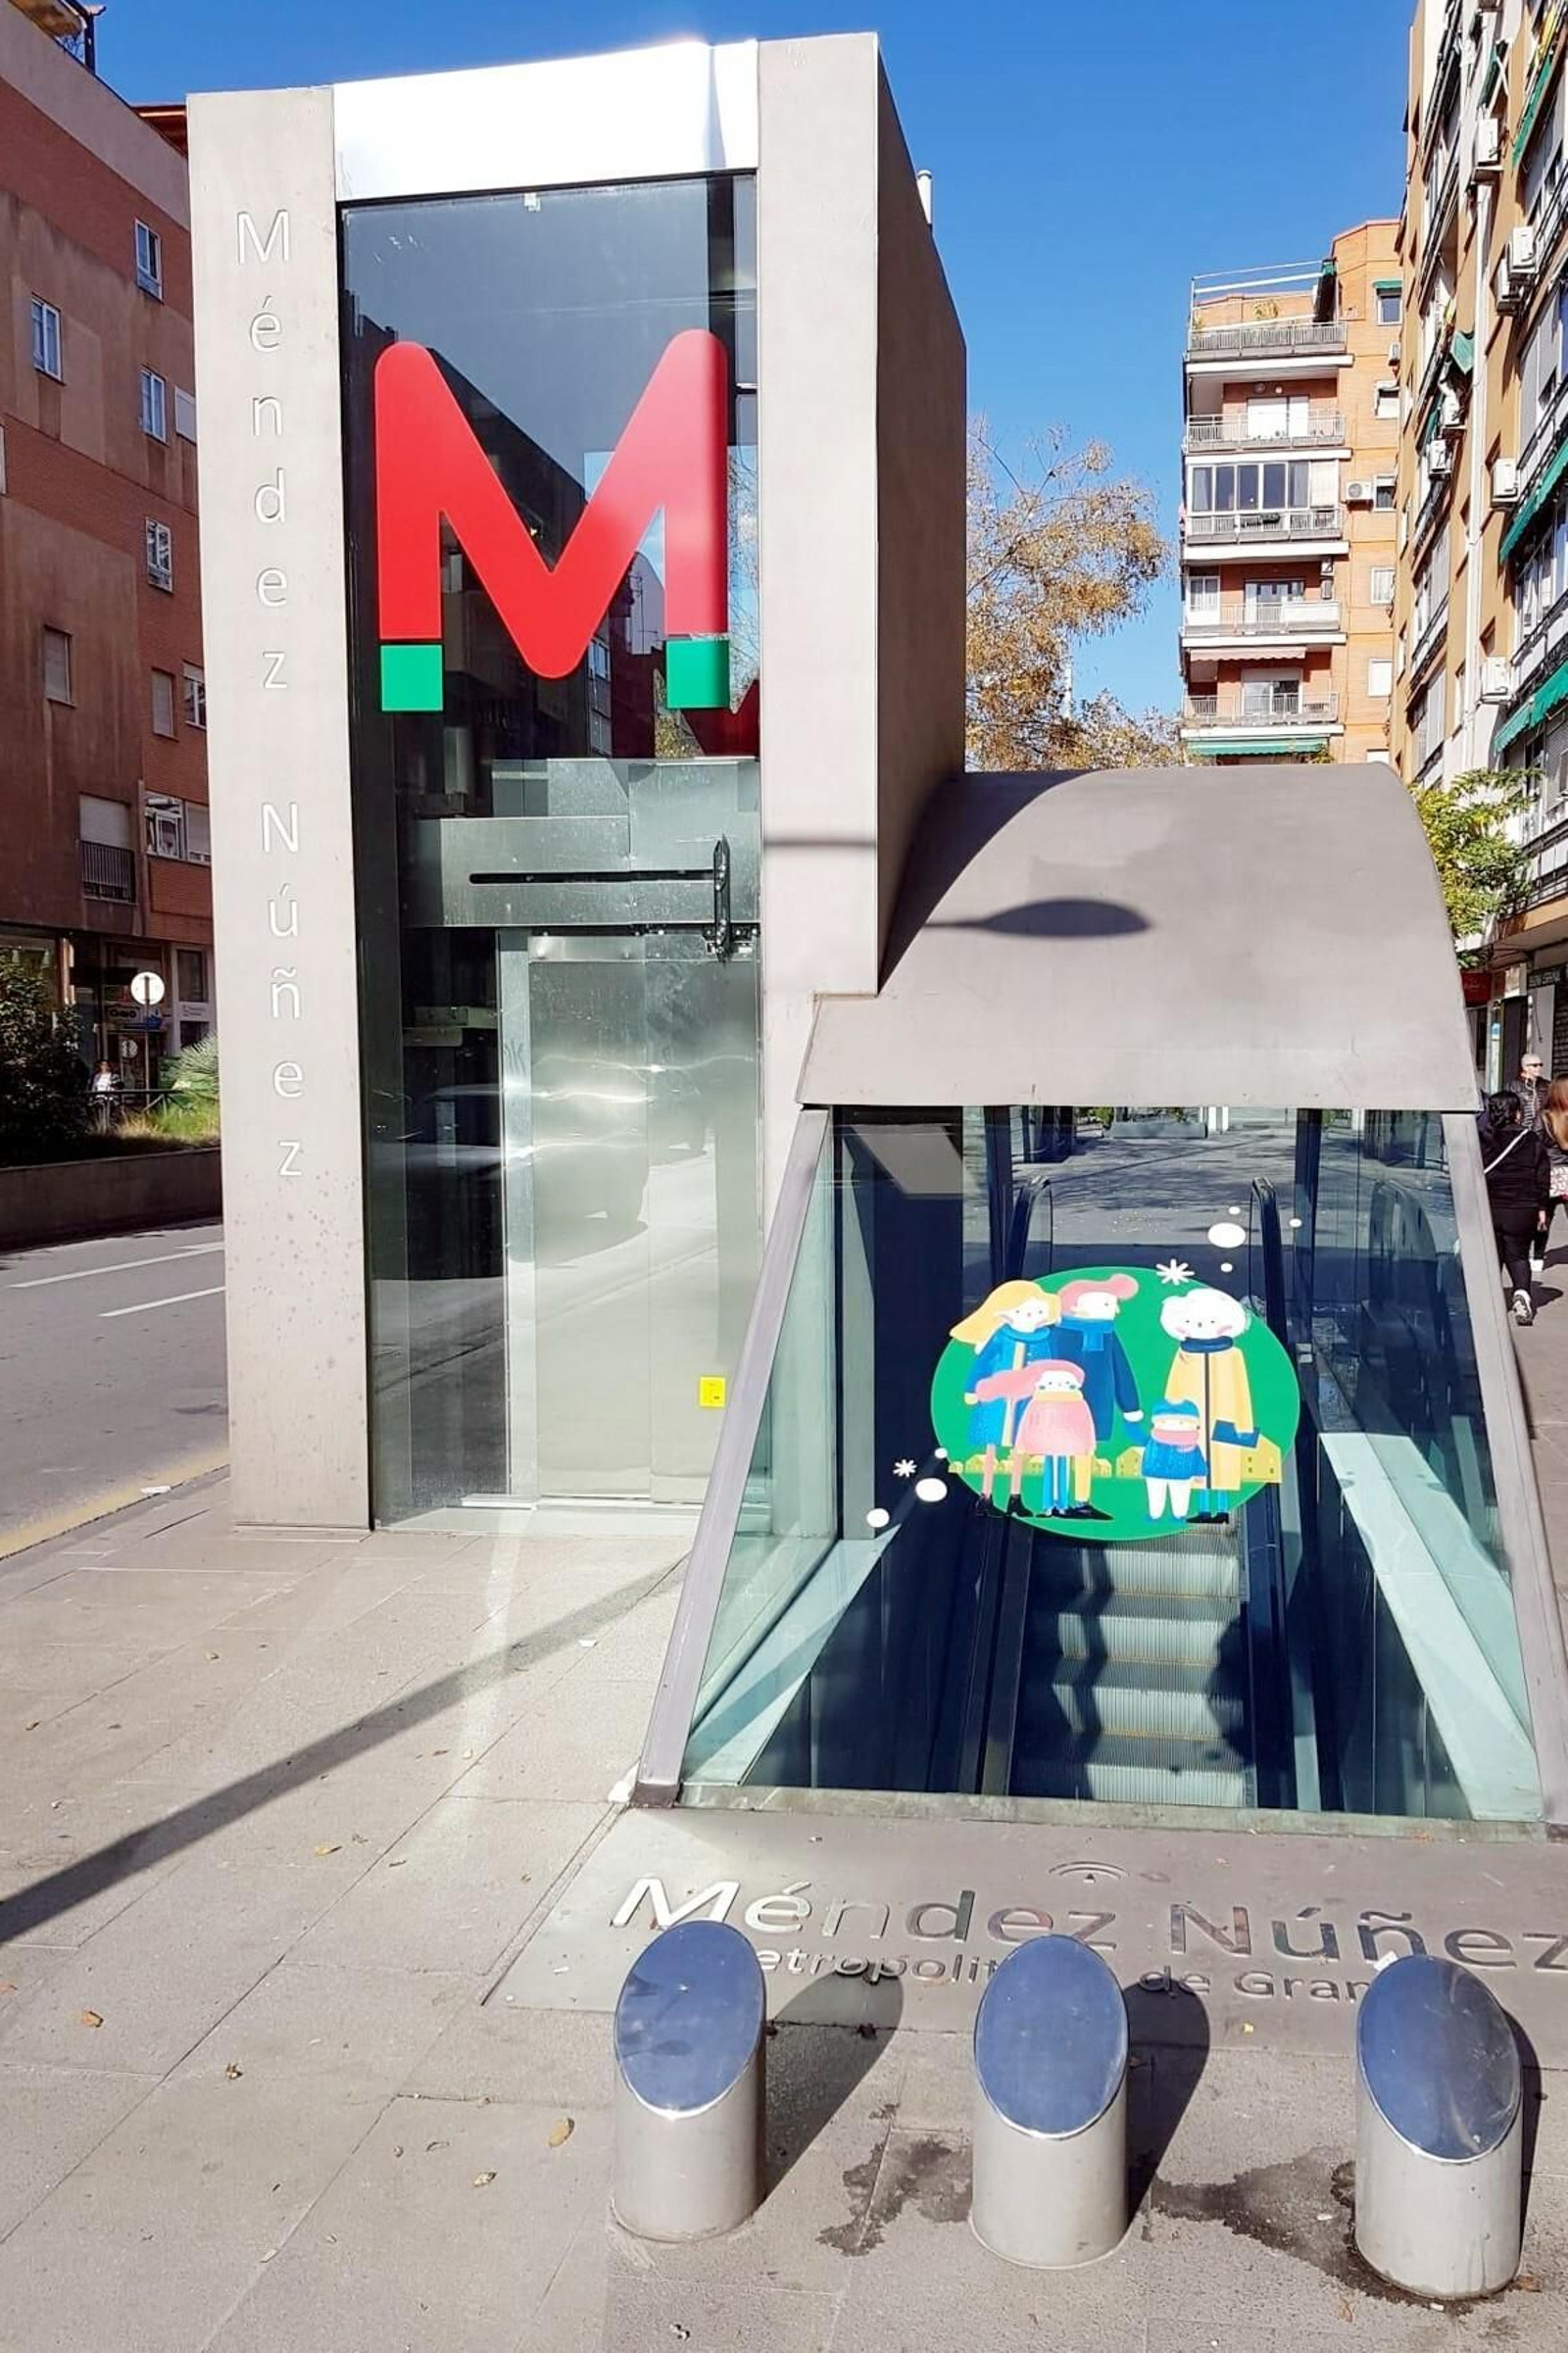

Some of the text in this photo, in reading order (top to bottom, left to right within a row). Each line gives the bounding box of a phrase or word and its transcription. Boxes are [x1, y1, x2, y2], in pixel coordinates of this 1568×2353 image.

[374, 328, 729, 711] M
[236, 210, 304, 1176] Méndez Núñez
[610, 1875, 1568, 1973] Méndez Núñez
[756, 1947, 1370, 2003] etropolit de Gran
